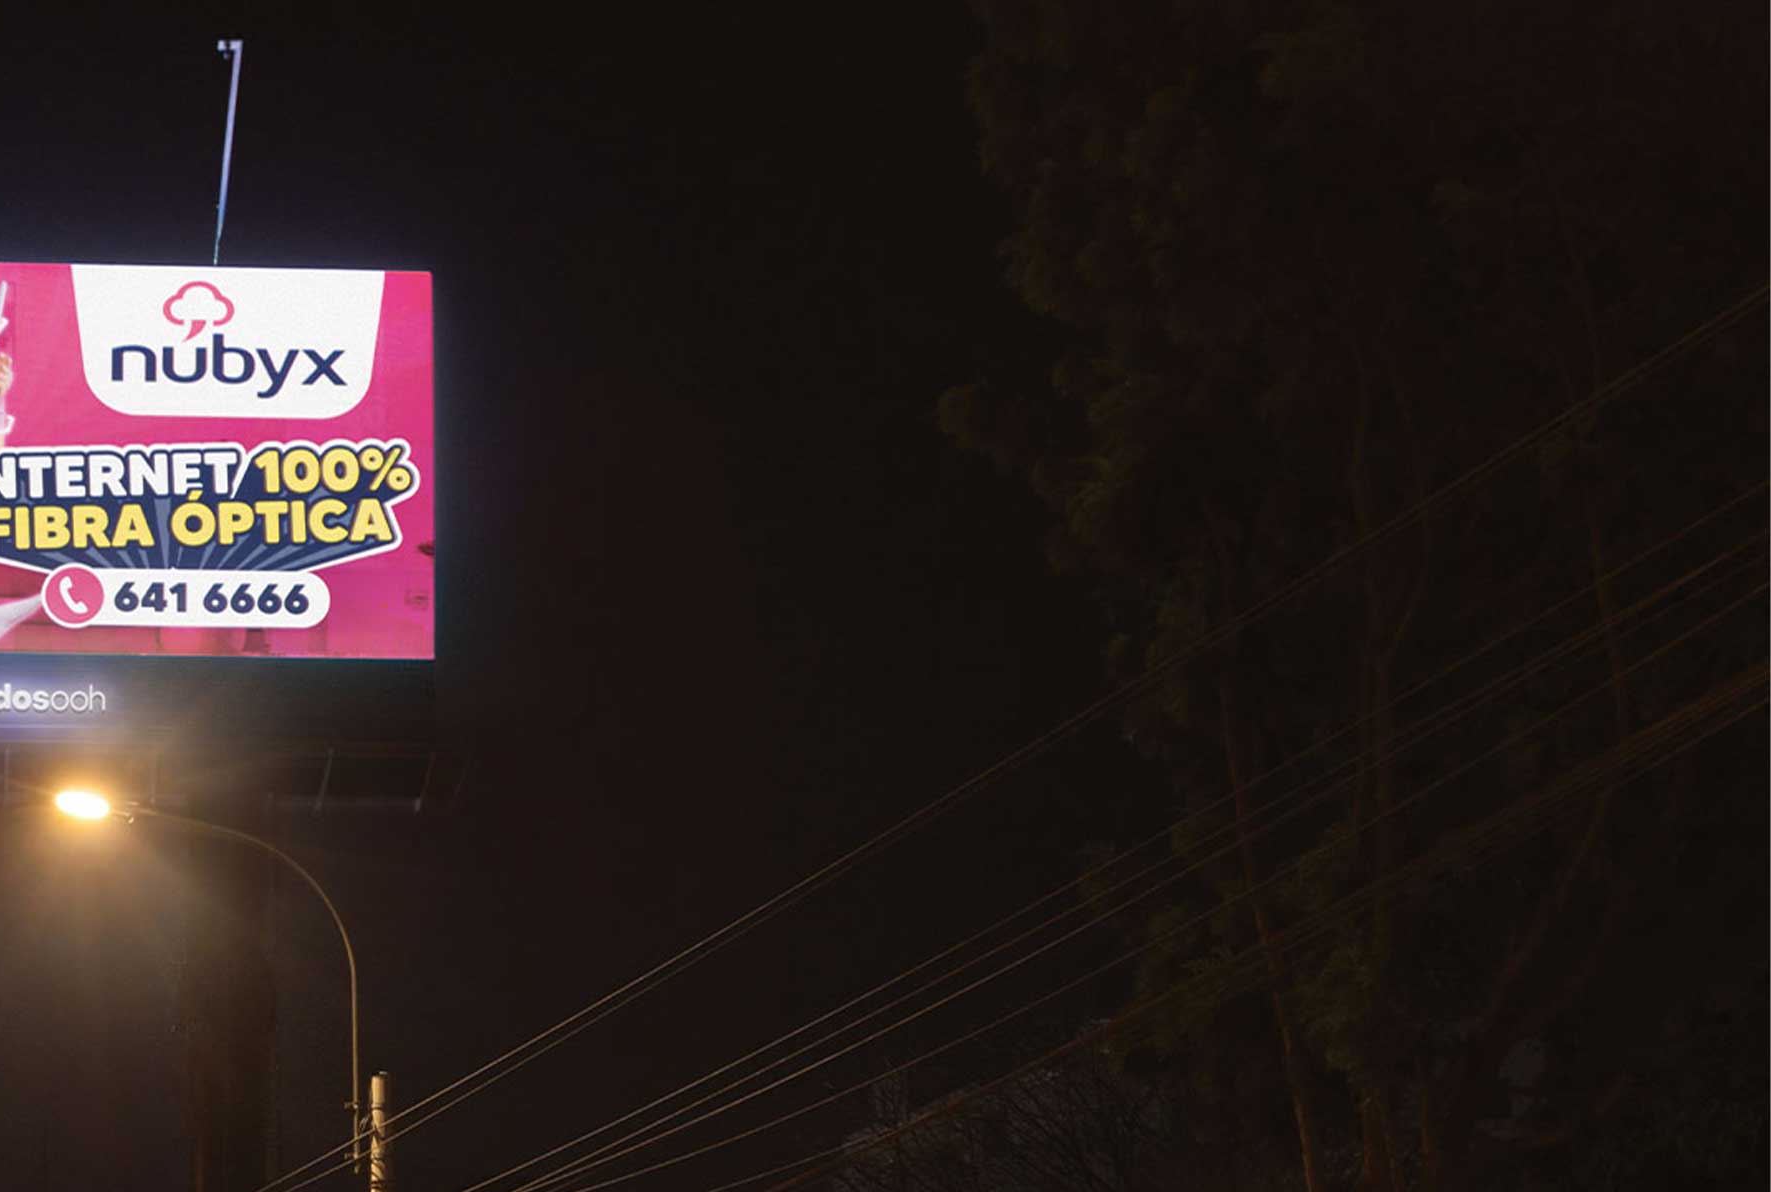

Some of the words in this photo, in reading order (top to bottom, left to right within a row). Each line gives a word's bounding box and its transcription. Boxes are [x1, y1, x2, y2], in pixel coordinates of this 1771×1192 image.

[111, 333, 347, 399] nubyx
[254, 447, 412, 494] 100%
[171, 490, 393, 546] ÓPTICA
[114, 582, 187, 612] 641
[203, 583, 309, 614] 6666
